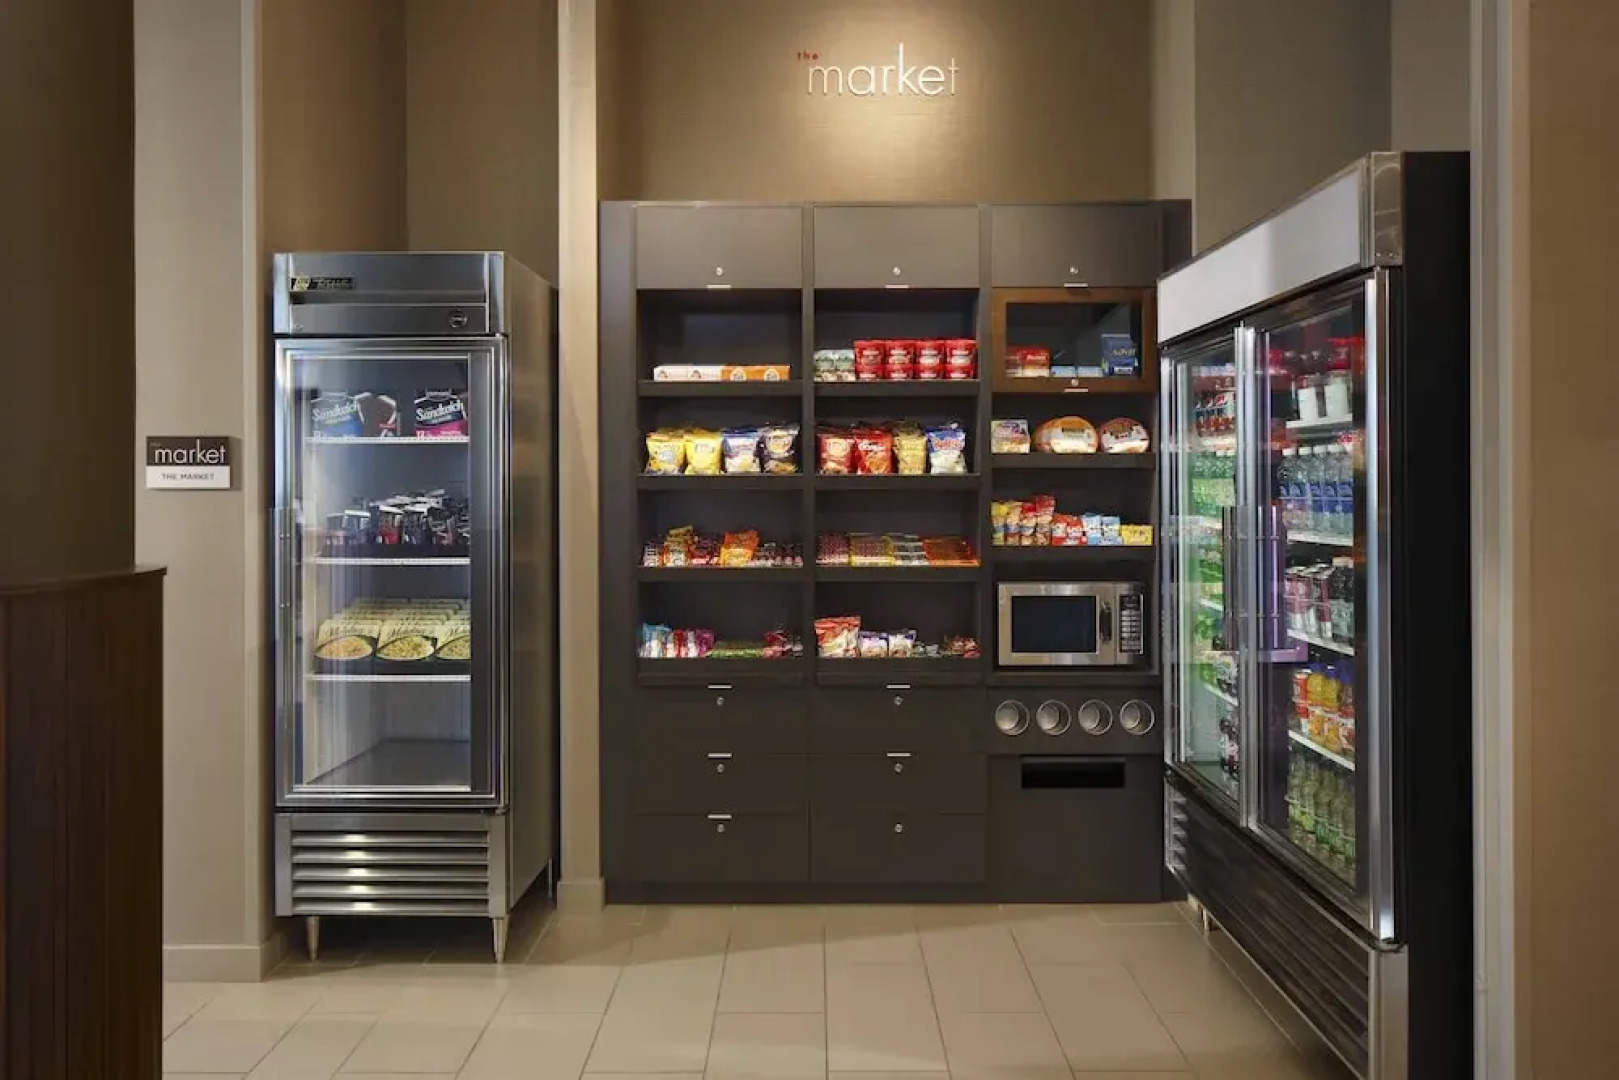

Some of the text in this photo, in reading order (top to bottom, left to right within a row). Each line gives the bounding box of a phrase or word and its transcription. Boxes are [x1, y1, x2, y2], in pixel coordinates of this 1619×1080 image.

[797, 50, 819, 61] the
[808, 41, 959, 95] market
[153, 438, 226, 464] market
